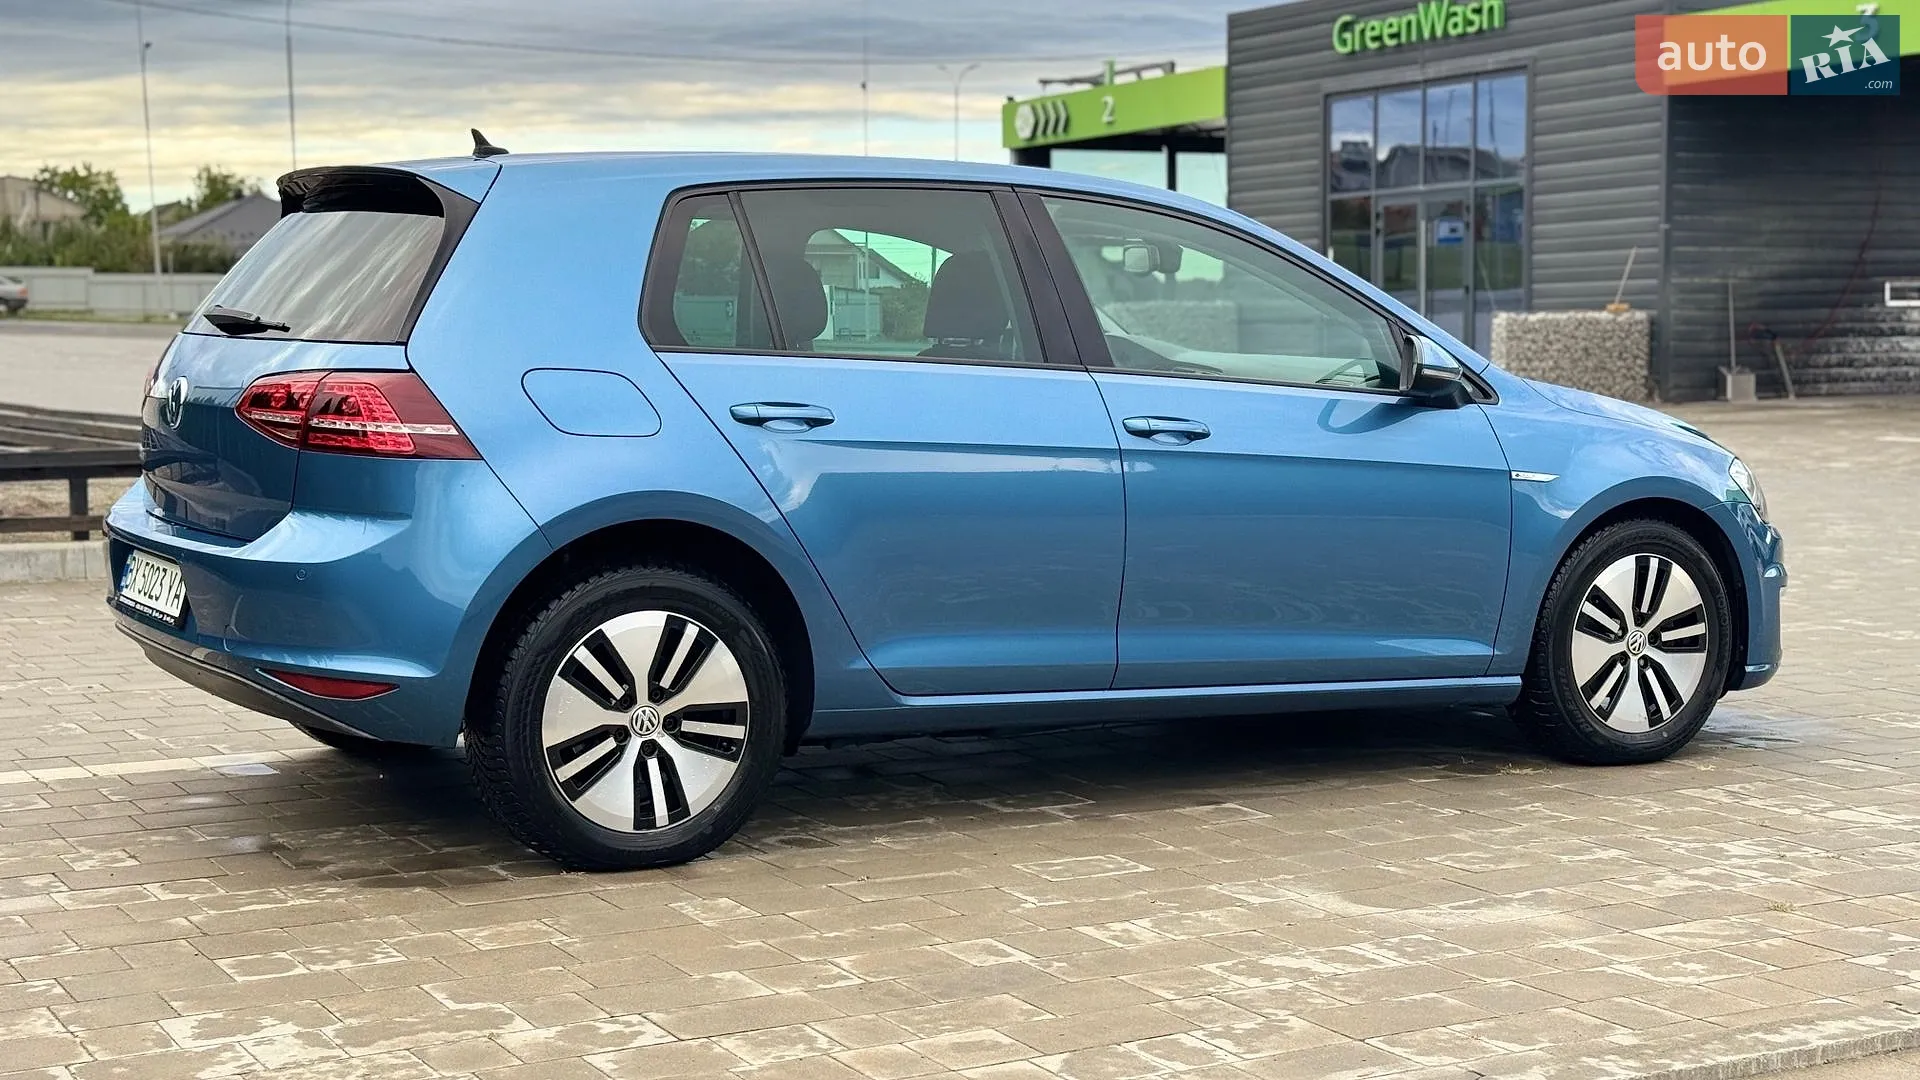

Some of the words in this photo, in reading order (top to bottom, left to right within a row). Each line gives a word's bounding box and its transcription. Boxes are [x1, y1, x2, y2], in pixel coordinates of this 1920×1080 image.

[1332, 0, 1506, 54] GreenWash
[1101, 95, 1115, 124] 2
[138, 561, 168, 602] 5023
[165, 570, 183, 609] YA
